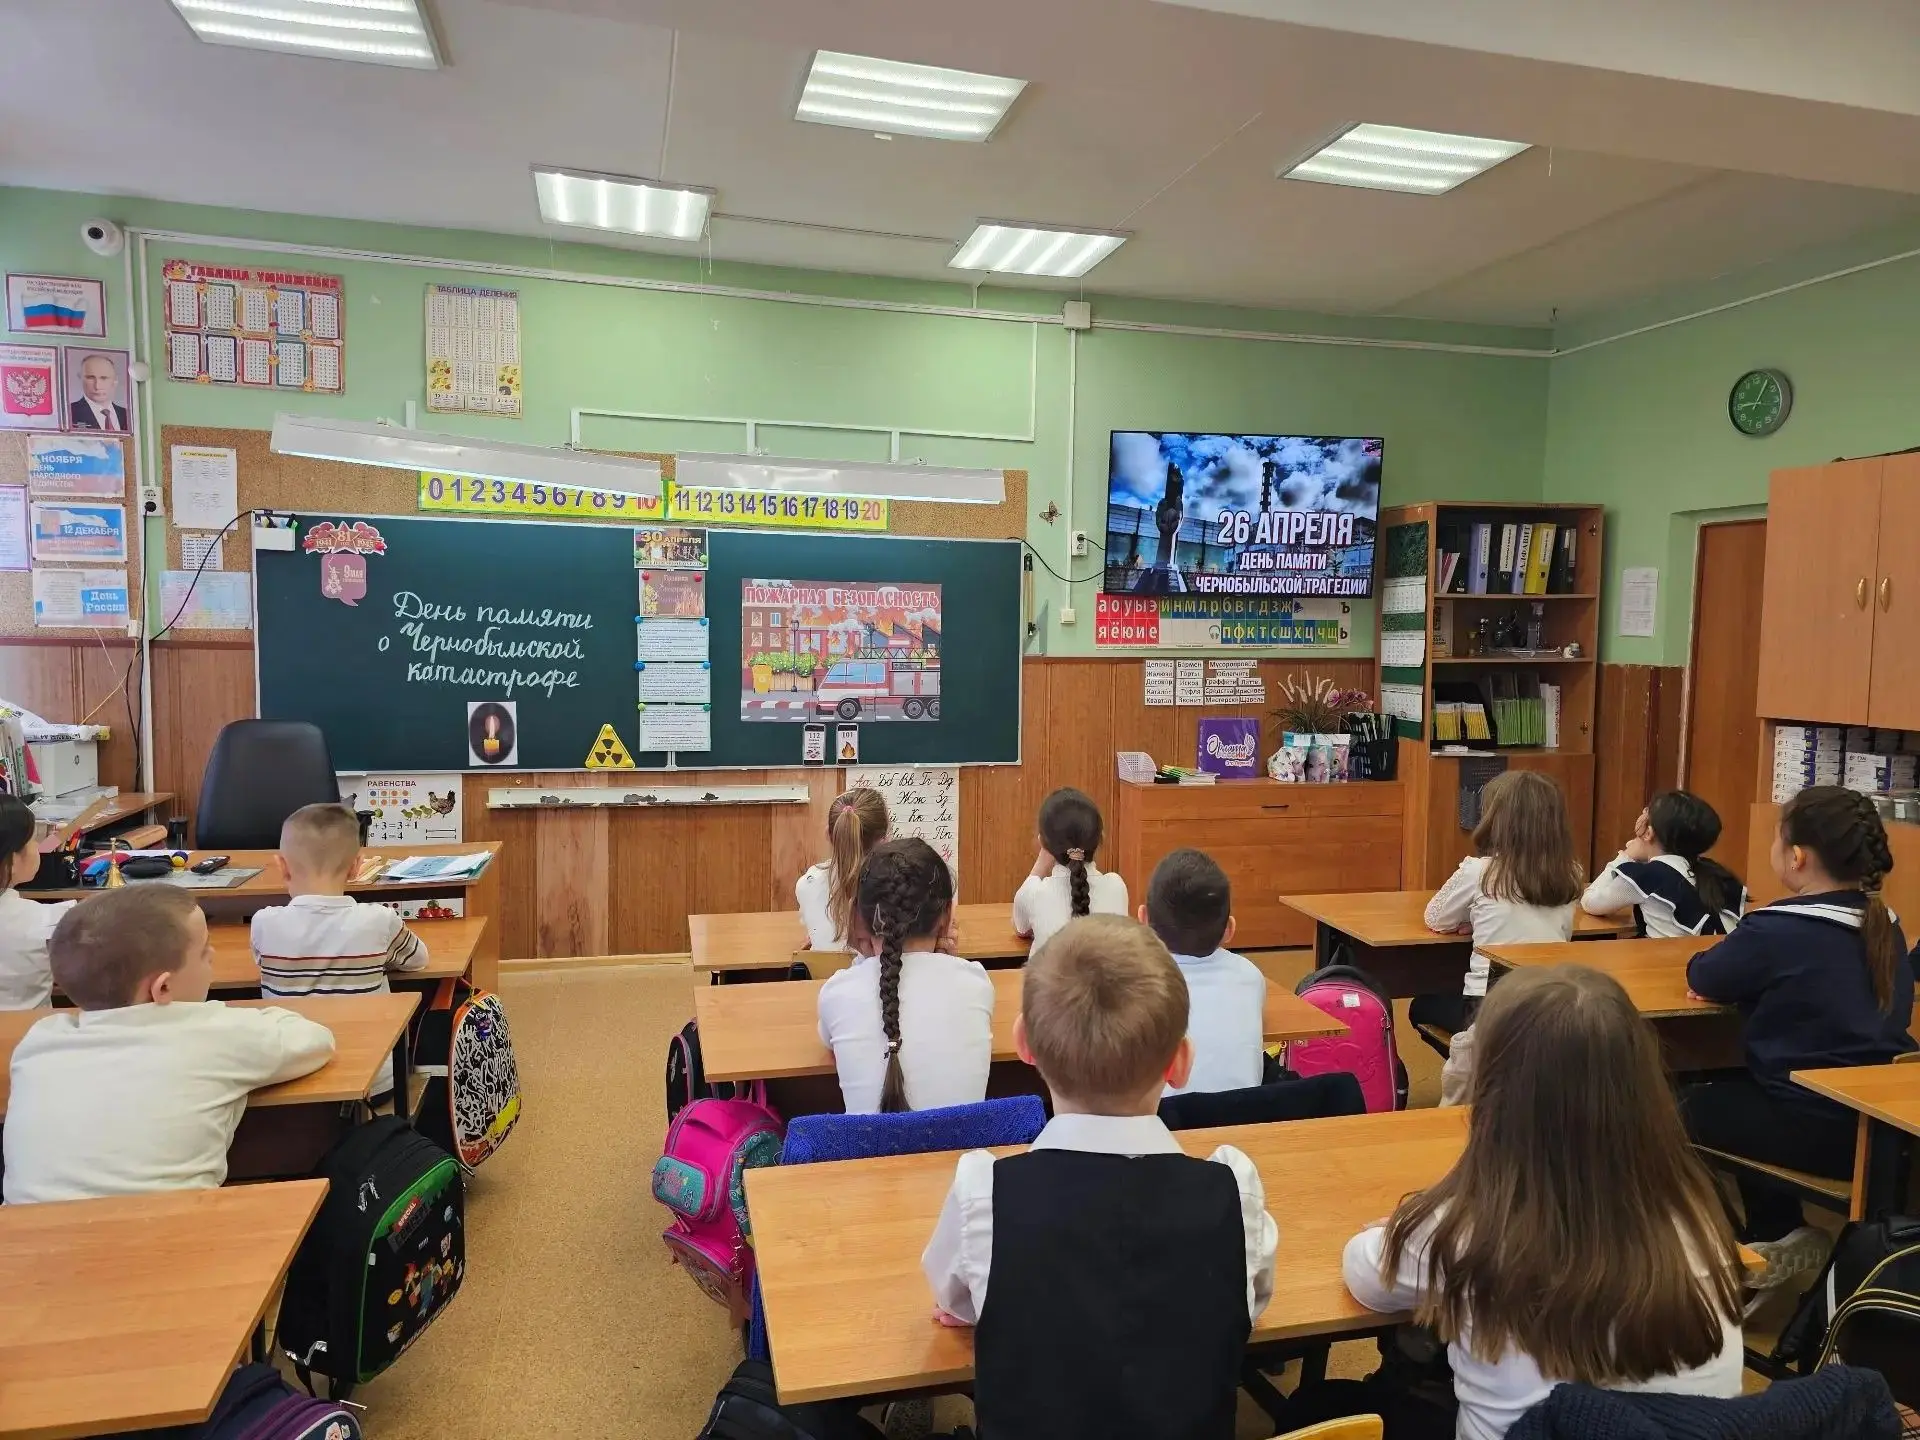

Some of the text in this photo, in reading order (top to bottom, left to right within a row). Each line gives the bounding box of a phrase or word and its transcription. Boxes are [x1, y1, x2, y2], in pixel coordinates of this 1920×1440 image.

[190, 265, 339, 288] ТАБЛИЦА УМНОЖЕНИЯ
[437, 286, 517, 298] ТАБЛИЦА ДЕЛЕНИЯ
[41, 455, 83, 464] НОЯБРЯ
[33, 472, 81, 480] НАРОДНОГО
[428, 478, 443, 500] 0
[450, 478, 463, 501] 1
[471, 480, 485, 502] 2
[491, 481, 505, 503] 3
[511, 483, 526, 504] 4
[532, 485, 547, 504] 5
[552, 487, 567, 506] 6
[592, 492, 606, 507] 8
[675, 491, 881, 521] 11 12 13 14 15 16 17 18 19 20
[63, 525, 119, 535] 12 ДЕКАБРЯ
[337, 531, 351, 542] 81
[1217, 511, 1354, 545] 26 АПРЕЛЯ
[316, 539, 332, 547] 1941
[357, 540, 374, 548] 1945
[640, 531, 702, 544] 30 АПРЕЛЯ
[1520, 526, 1531, 570] АЛФАВИТ
[1240, 553, 1327, 570] ДЕНЬ ПАМЯТИ
[343, 565, 350, 578] 9
[1196, 576, 1367, 594] ЧЕРНОБЫЛЬСКОЙ ТРАГЕДИИ
[91, 591, 119, 601] День
[745, 587, 939, 608] ПОЖАРНАЯ БЕЗОПАСНОСТЬ
[85, 603, 125, 611] России
[393, 591, 594, 629] День памяти
[1099, 596, 1350, 616] а о у ы э й н м л р б в г д з ж ъ
[1099, 622, 1348, 643] я ё ю и е п ф к т с ш х ц ч щ ь
[378, 622, 585, 663] о Чернобыльской
[407, 662, 580, 698] катастрофе
[851, 771, 954, 790] Аа Бб Вв Гг Дд
[897, 790, 948, 808] Жж Зз
[909, 808, 925, 823] Кк
[933, 808, 953, 821] Лл
[381, 821, 387, 830] 3
[397, 821, 403, 830] 3
[414, 821, 418, 829] 1
[933, 825, 953, 840] Пп
[381, 832, 387, 840] 4
[397, 832, 403, 840] 4
[398, 1202, 417, 1227] SPECIAL
